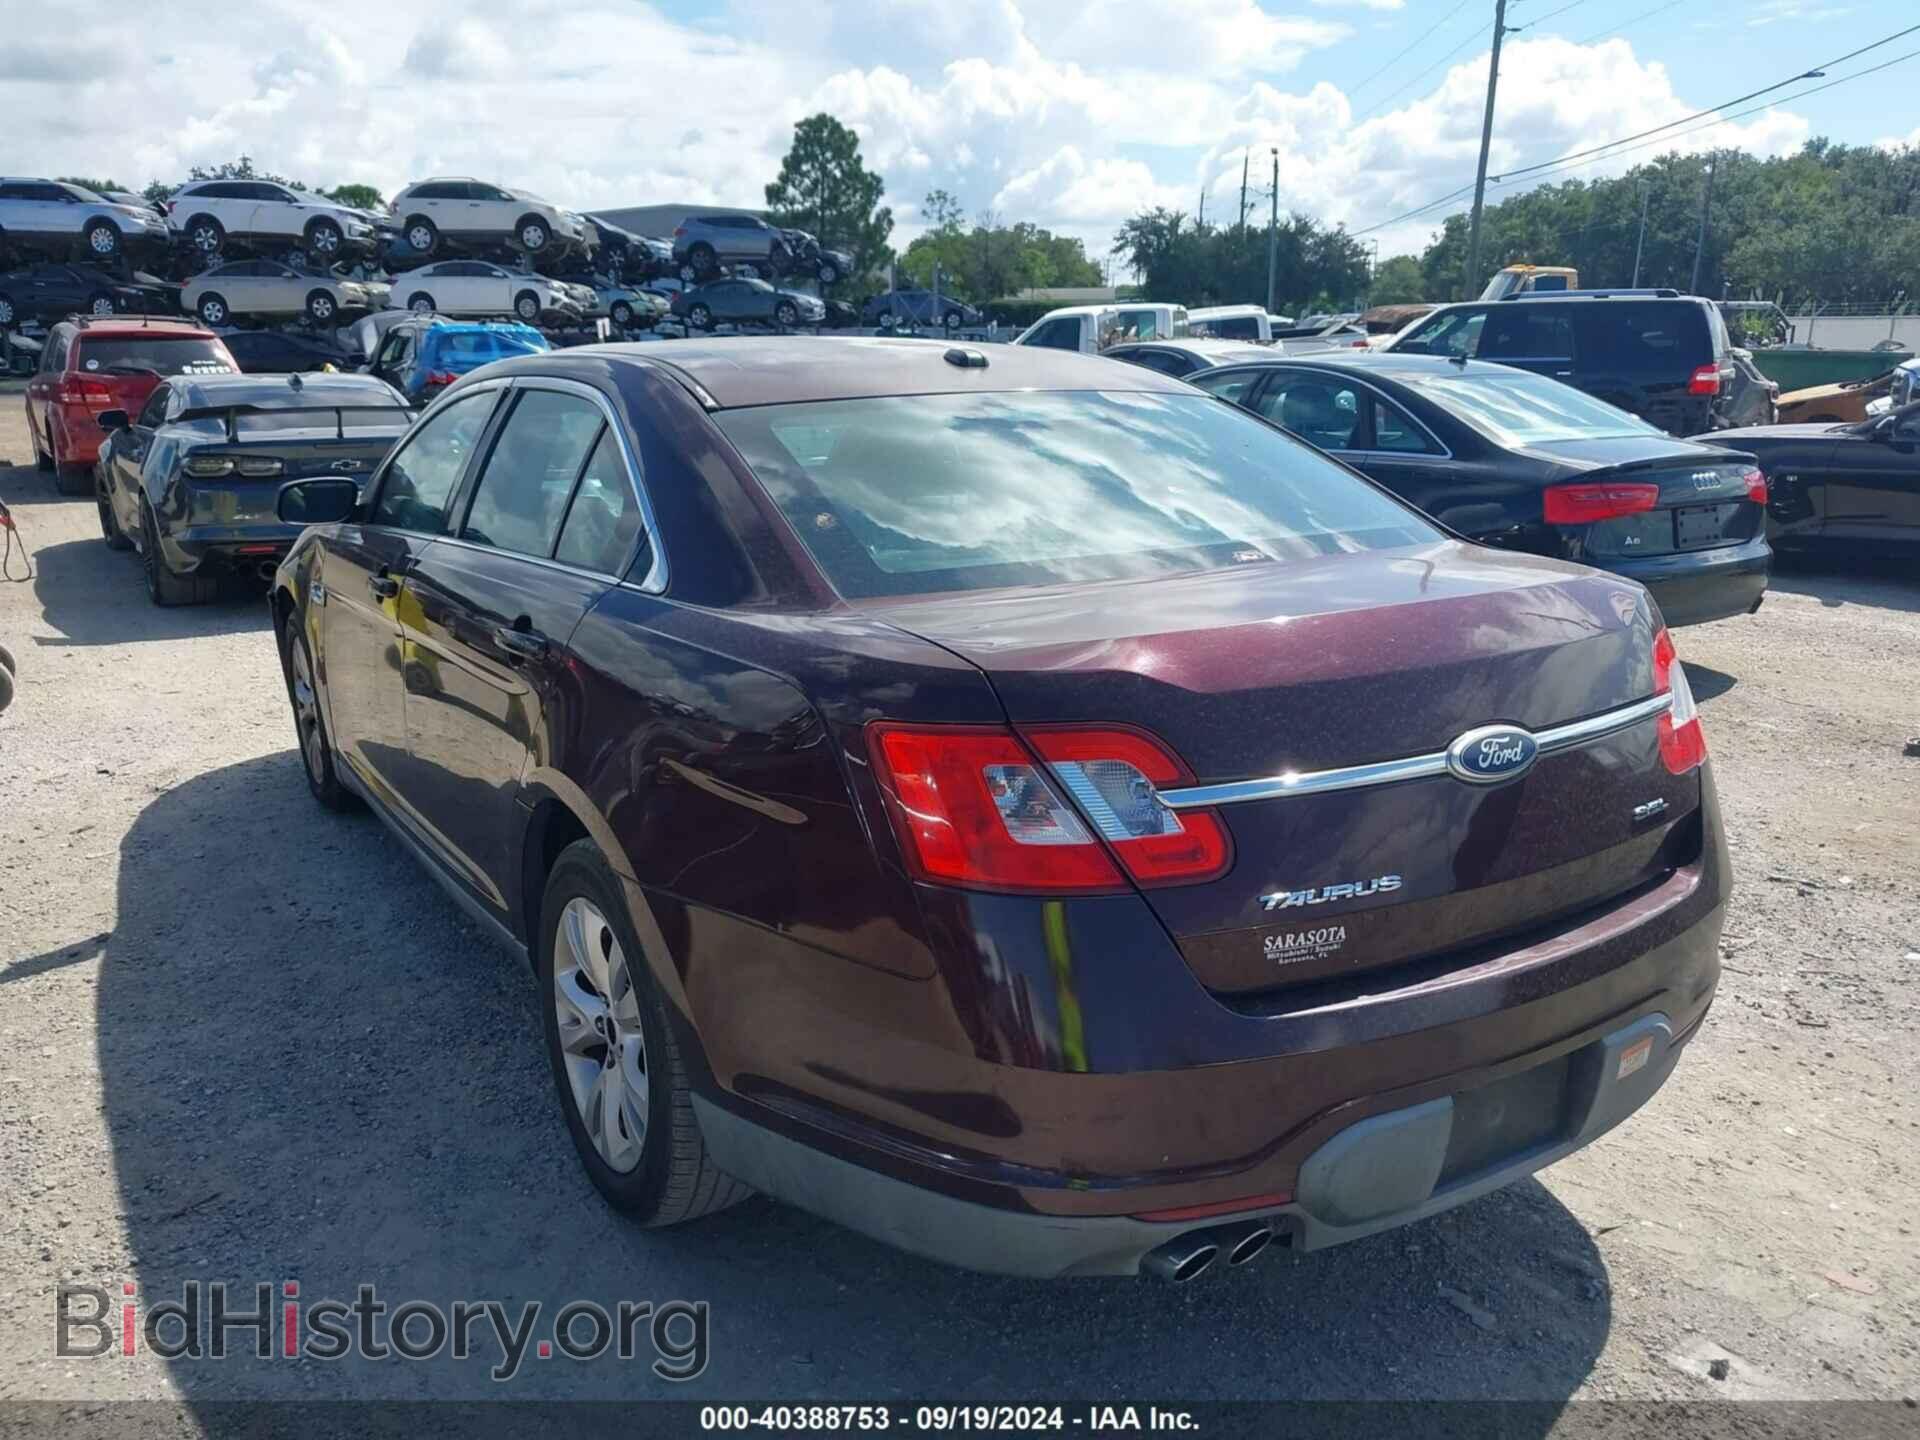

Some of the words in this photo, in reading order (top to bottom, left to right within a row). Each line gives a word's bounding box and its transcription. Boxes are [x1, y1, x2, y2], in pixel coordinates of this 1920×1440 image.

[1478, 735, 1524, 769] Ford
[1258, 875, 1403, 911] TAURUS
[1263, 926, 1346, 951] SARASOTA
